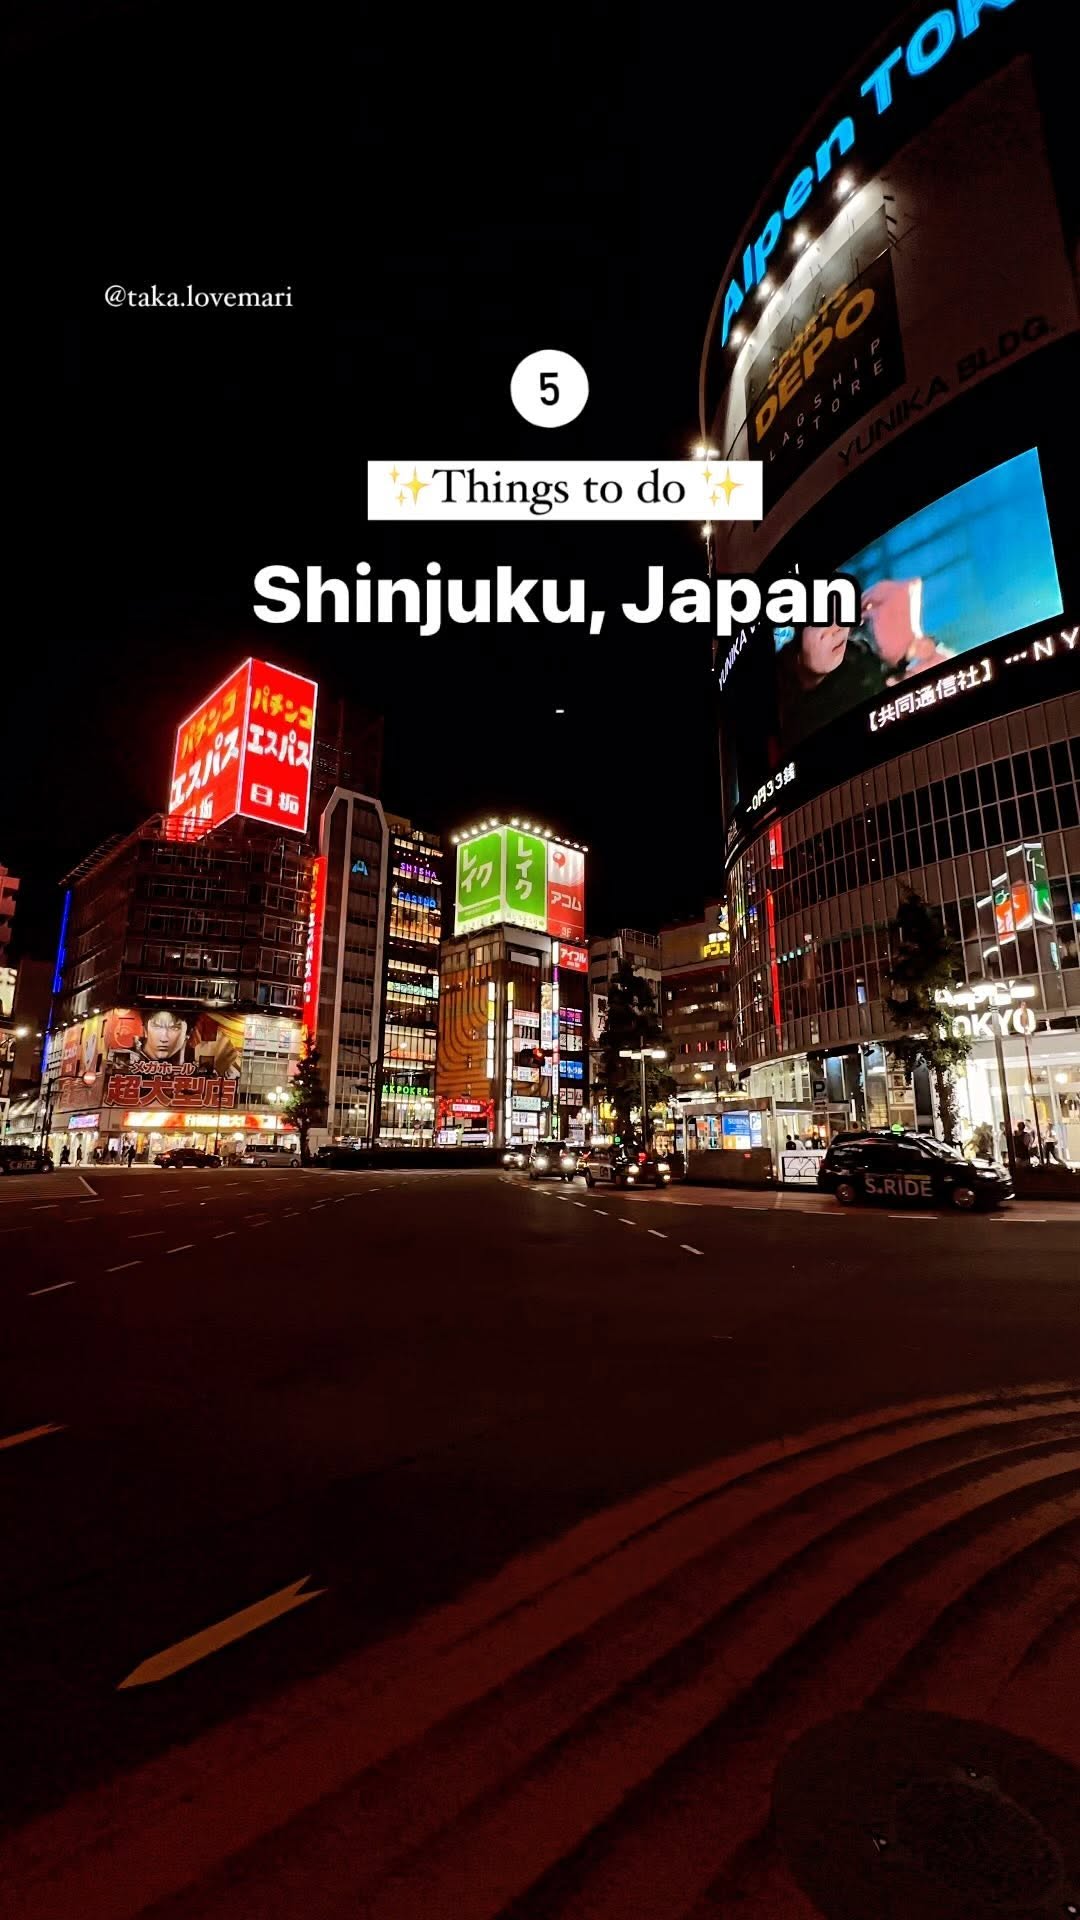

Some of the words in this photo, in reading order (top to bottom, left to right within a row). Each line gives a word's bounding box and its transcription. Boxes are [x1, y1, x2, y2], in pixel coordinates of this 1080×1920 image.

[721, 117, 855, 347] Alpen
[755, 288, 875, 443] DEPO
[769, 337, 880, 461] LAGSHIP
[796, 359, 883, 449] STORE
[838, 376, 950, 467] YUNIKA
[181, 689, 238, 760] パチンコ
[252, 685, 314, 730] パチンコ
[170, 726, 240, 810] エスパス
[247, 723, 311, 770] エスパス
[400, 862, 437, 879] SHISHA
[460, 848, 493, 893] レイク
[515, 836, 533, 900] レイク
[398, 891, 437, 909] CASINO
[550, 890, 583, 912] アコム
[560, 947, 587, 963] アイフル
[106, 1074, 237, 1108] 超大型店
[131, 1061, 195, 1076] メガホール
[382, 1084, 429, 1097] KKPOKER
[865, 1178, 933, 1197] S.RIDE
